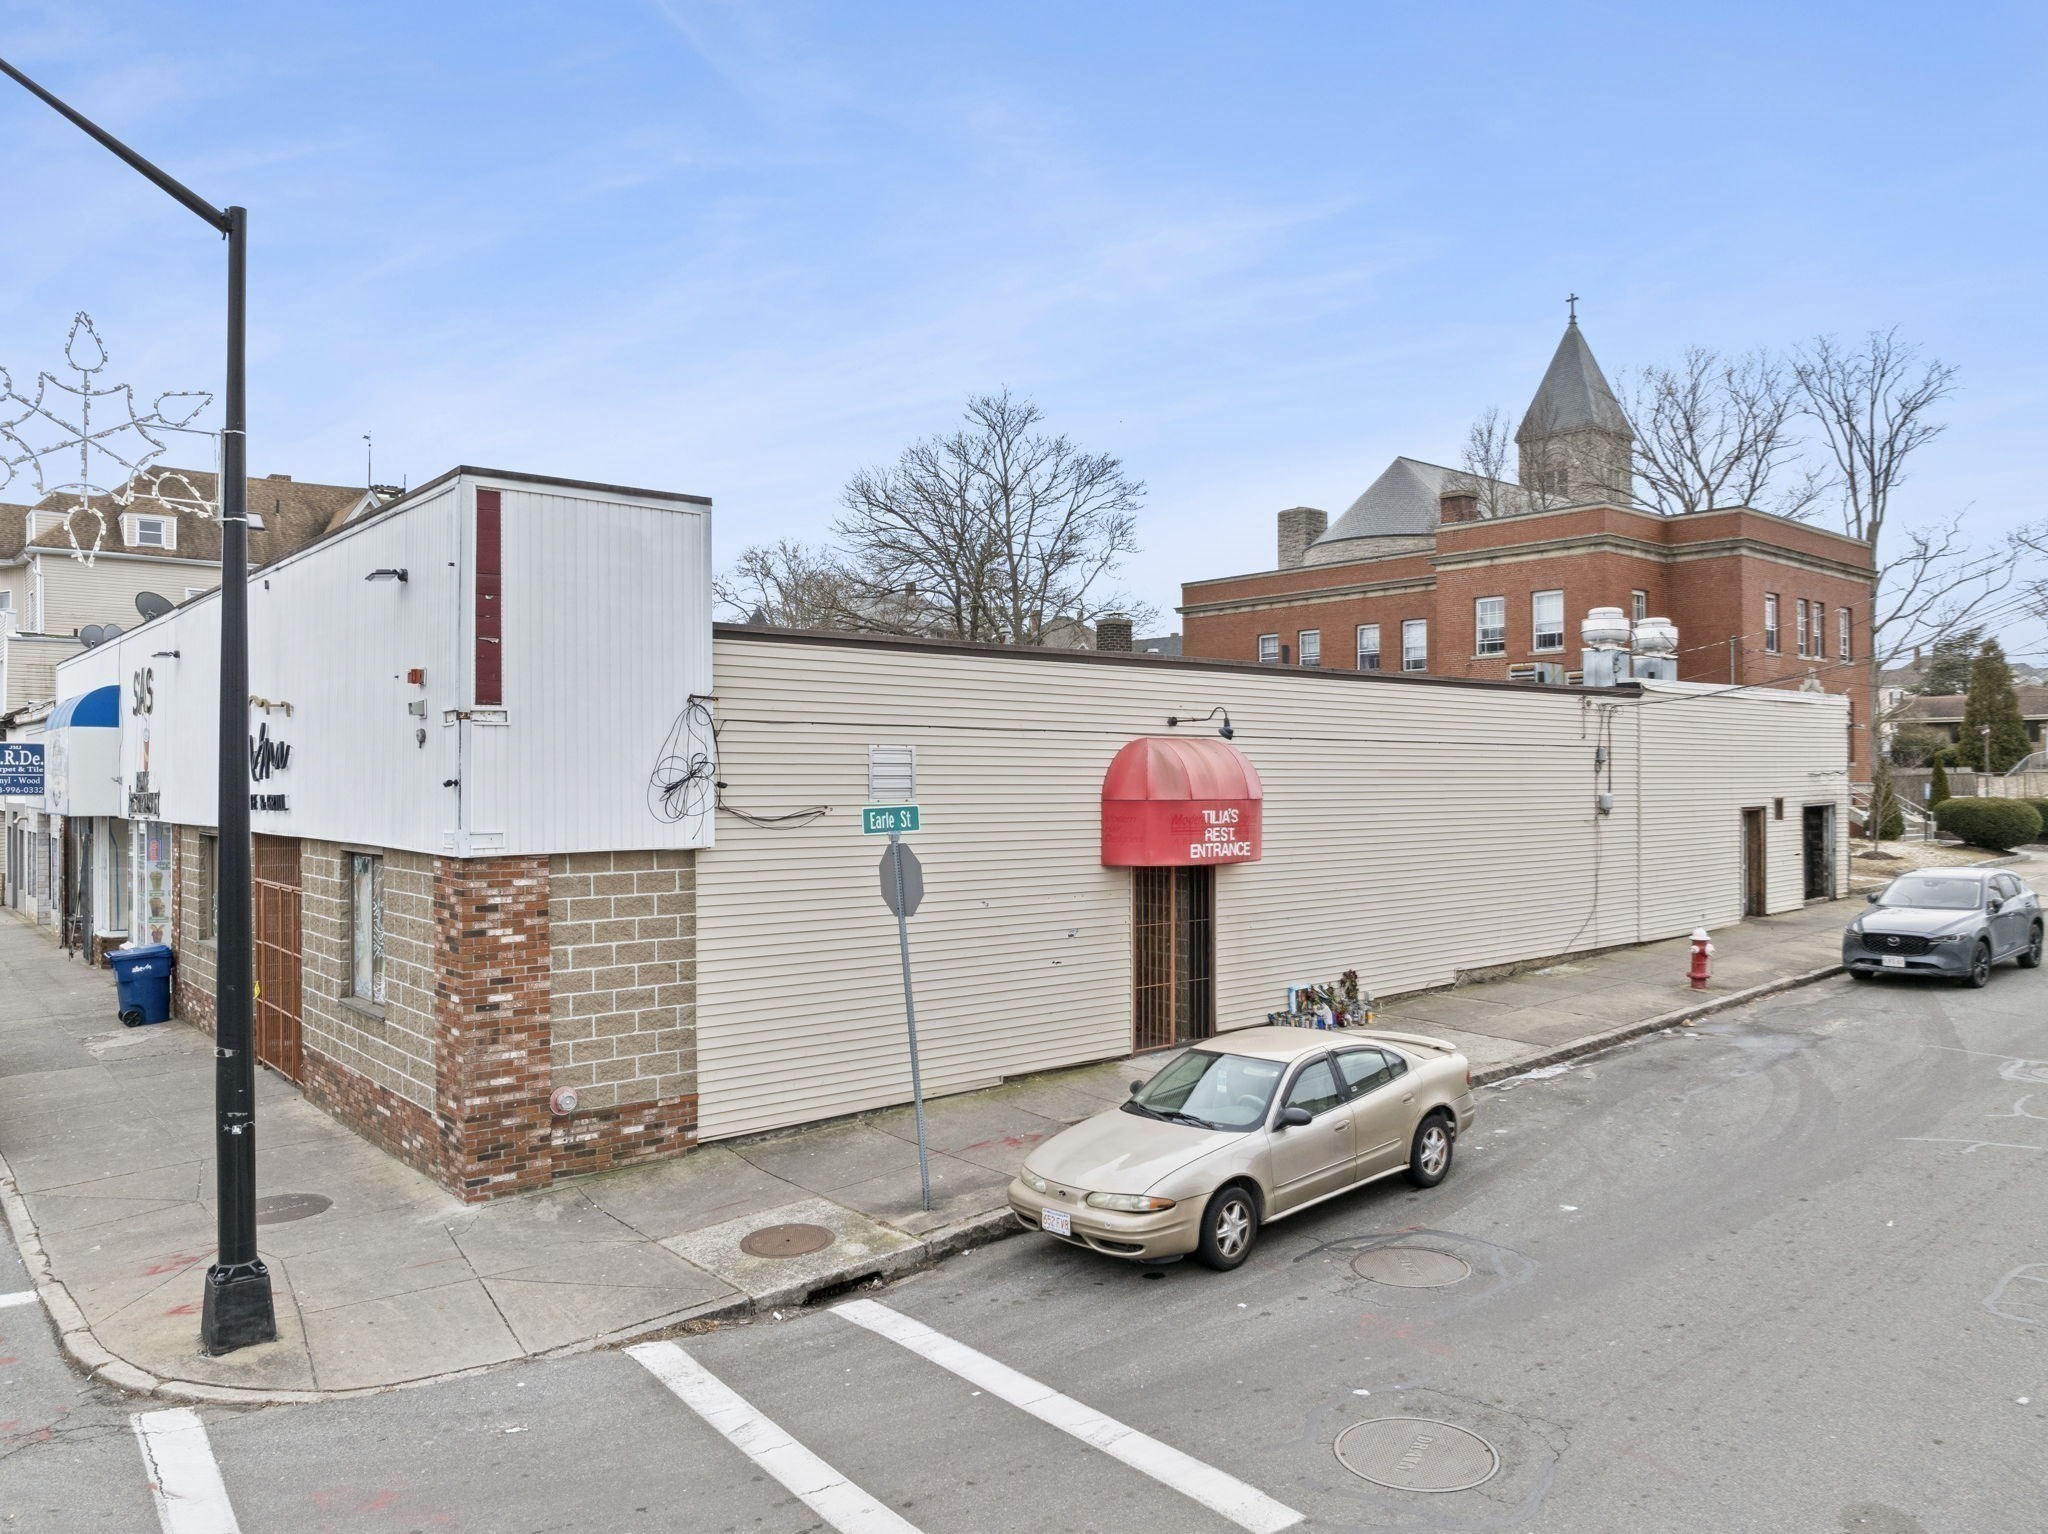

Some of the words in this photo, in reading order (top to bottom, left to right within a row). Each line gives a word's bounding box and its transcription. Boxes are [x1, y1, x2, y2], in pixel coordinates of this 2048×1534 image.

[869, 811, 895, 829] Earle
[900, 810, 911, 828] St
[1202, 808, 1239, 824] TILIA'S
[1205, 827, 1235, 841] REST.
[1190, 842, 1251, 858] ENTRANCE
